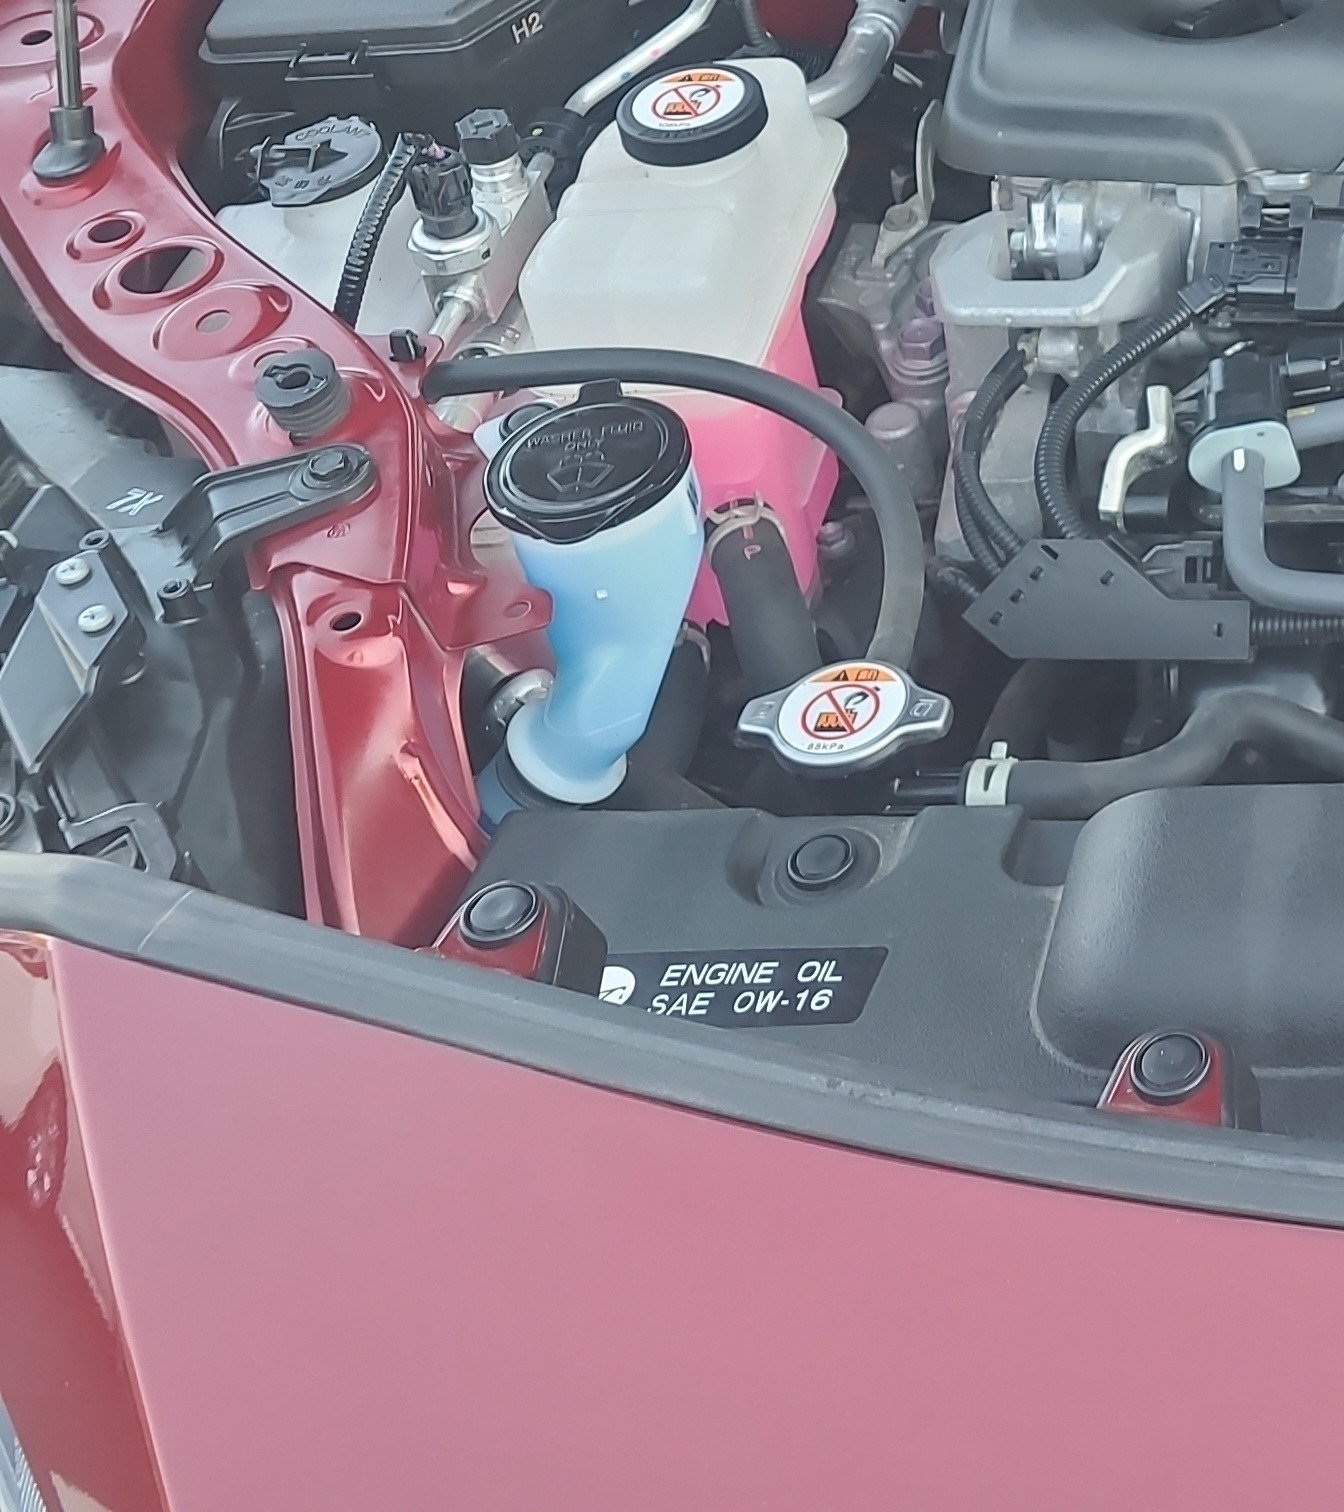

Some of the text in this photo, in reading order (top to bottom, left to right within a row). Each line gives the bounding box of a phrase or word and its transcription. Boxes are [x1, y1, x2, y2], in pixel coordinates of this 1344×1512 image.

[511, 12, 543, 44] H2
[659, 959, 844, 988] ENGINE OIL
[647, 988, 833, 1016] SAE 0W-16
